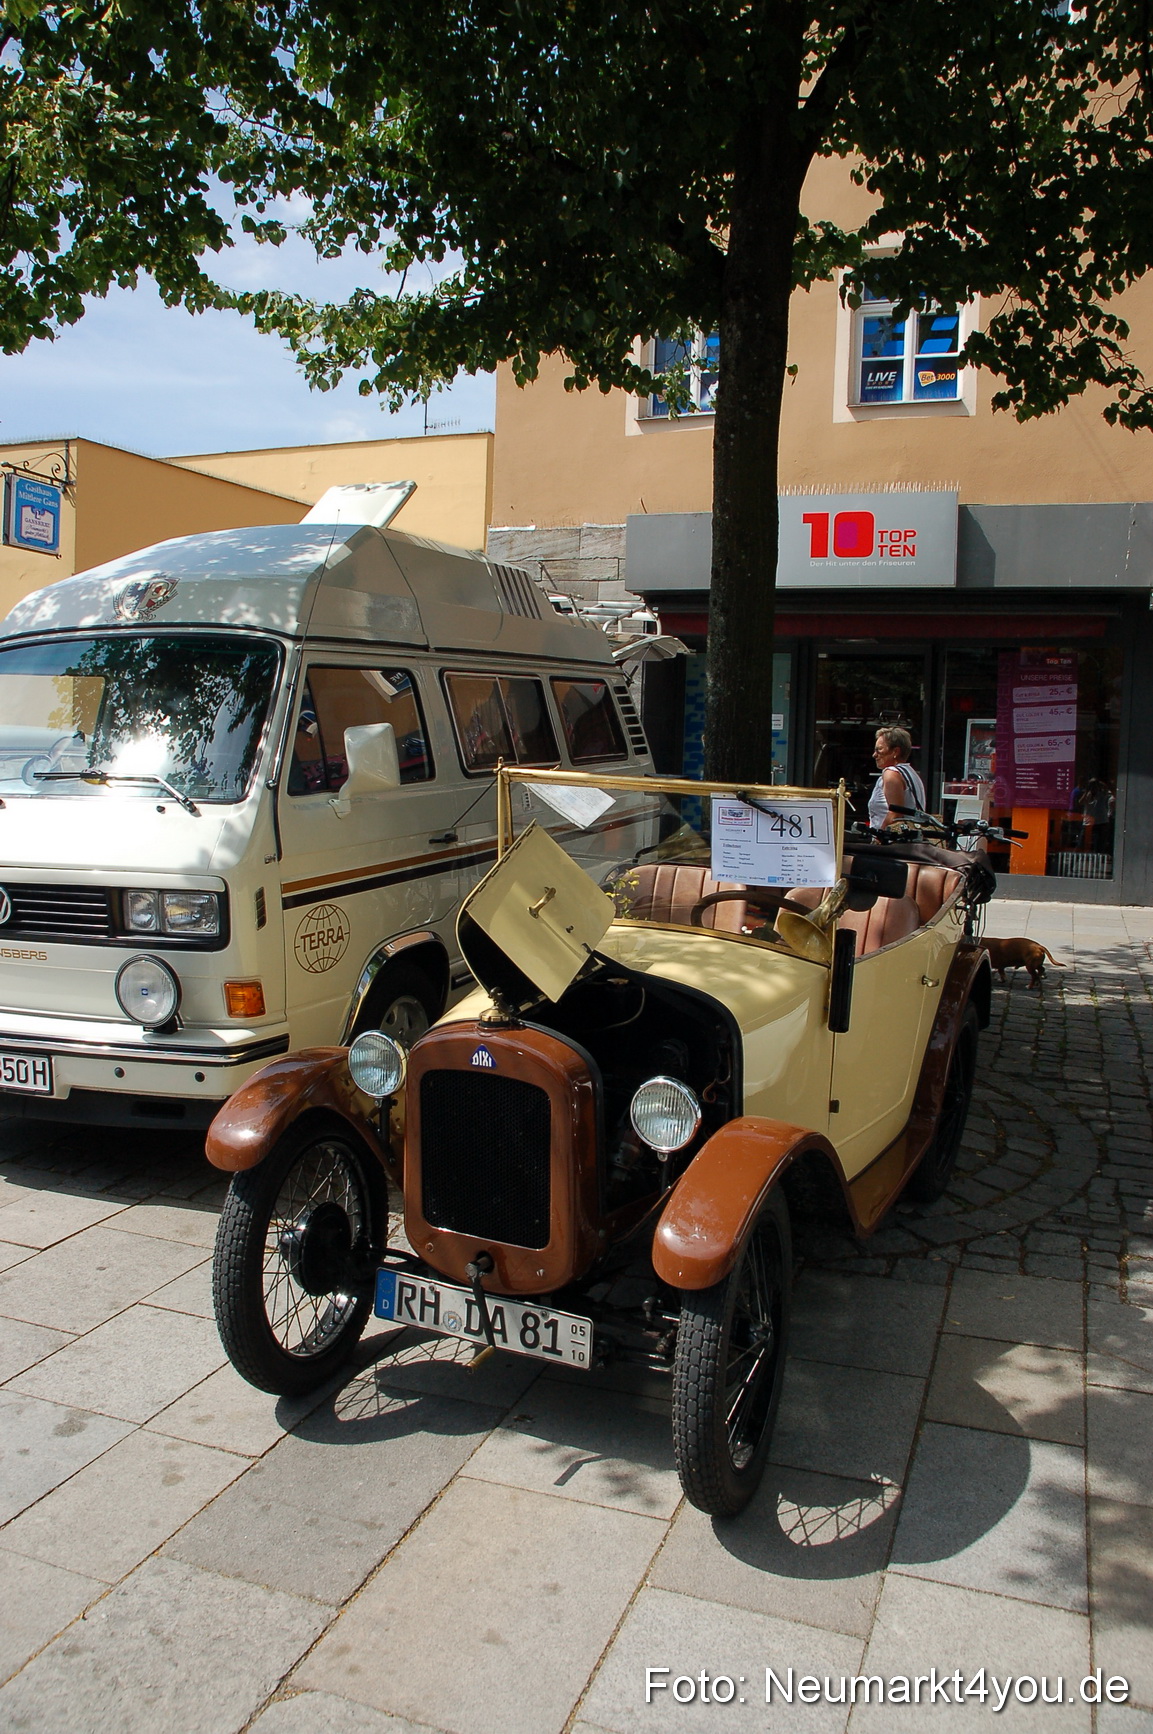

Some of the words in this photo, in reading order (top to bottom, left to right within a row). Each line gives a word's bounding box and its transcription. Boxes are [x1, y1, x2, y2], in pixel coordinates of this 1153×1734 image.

[867, 371, 897, 382] LIVE
[936, 373, 956, 381] 3000
[43, 497, 58, 508] Gans
[802, 511, 875, 559] 10
[878, 529, 917, 543] TOP
[878, 544, 917, 558] TEN
[770, 813, 817, 839] 481
[300, 925, 345, 953] TERRA
[472, 1050, 492, 1067] DIXI
[0, 1057, 47, 1086] 50H
[382, 1300, 389, 1309] D
[397, 1281, 441, 1326] RH
[464, 1298, 508, 1343] DA
[519, 1311, 563, 1357] 81
[570, 1324, 586, 1337] 05
[571, 1349, 585, 1362] 10
